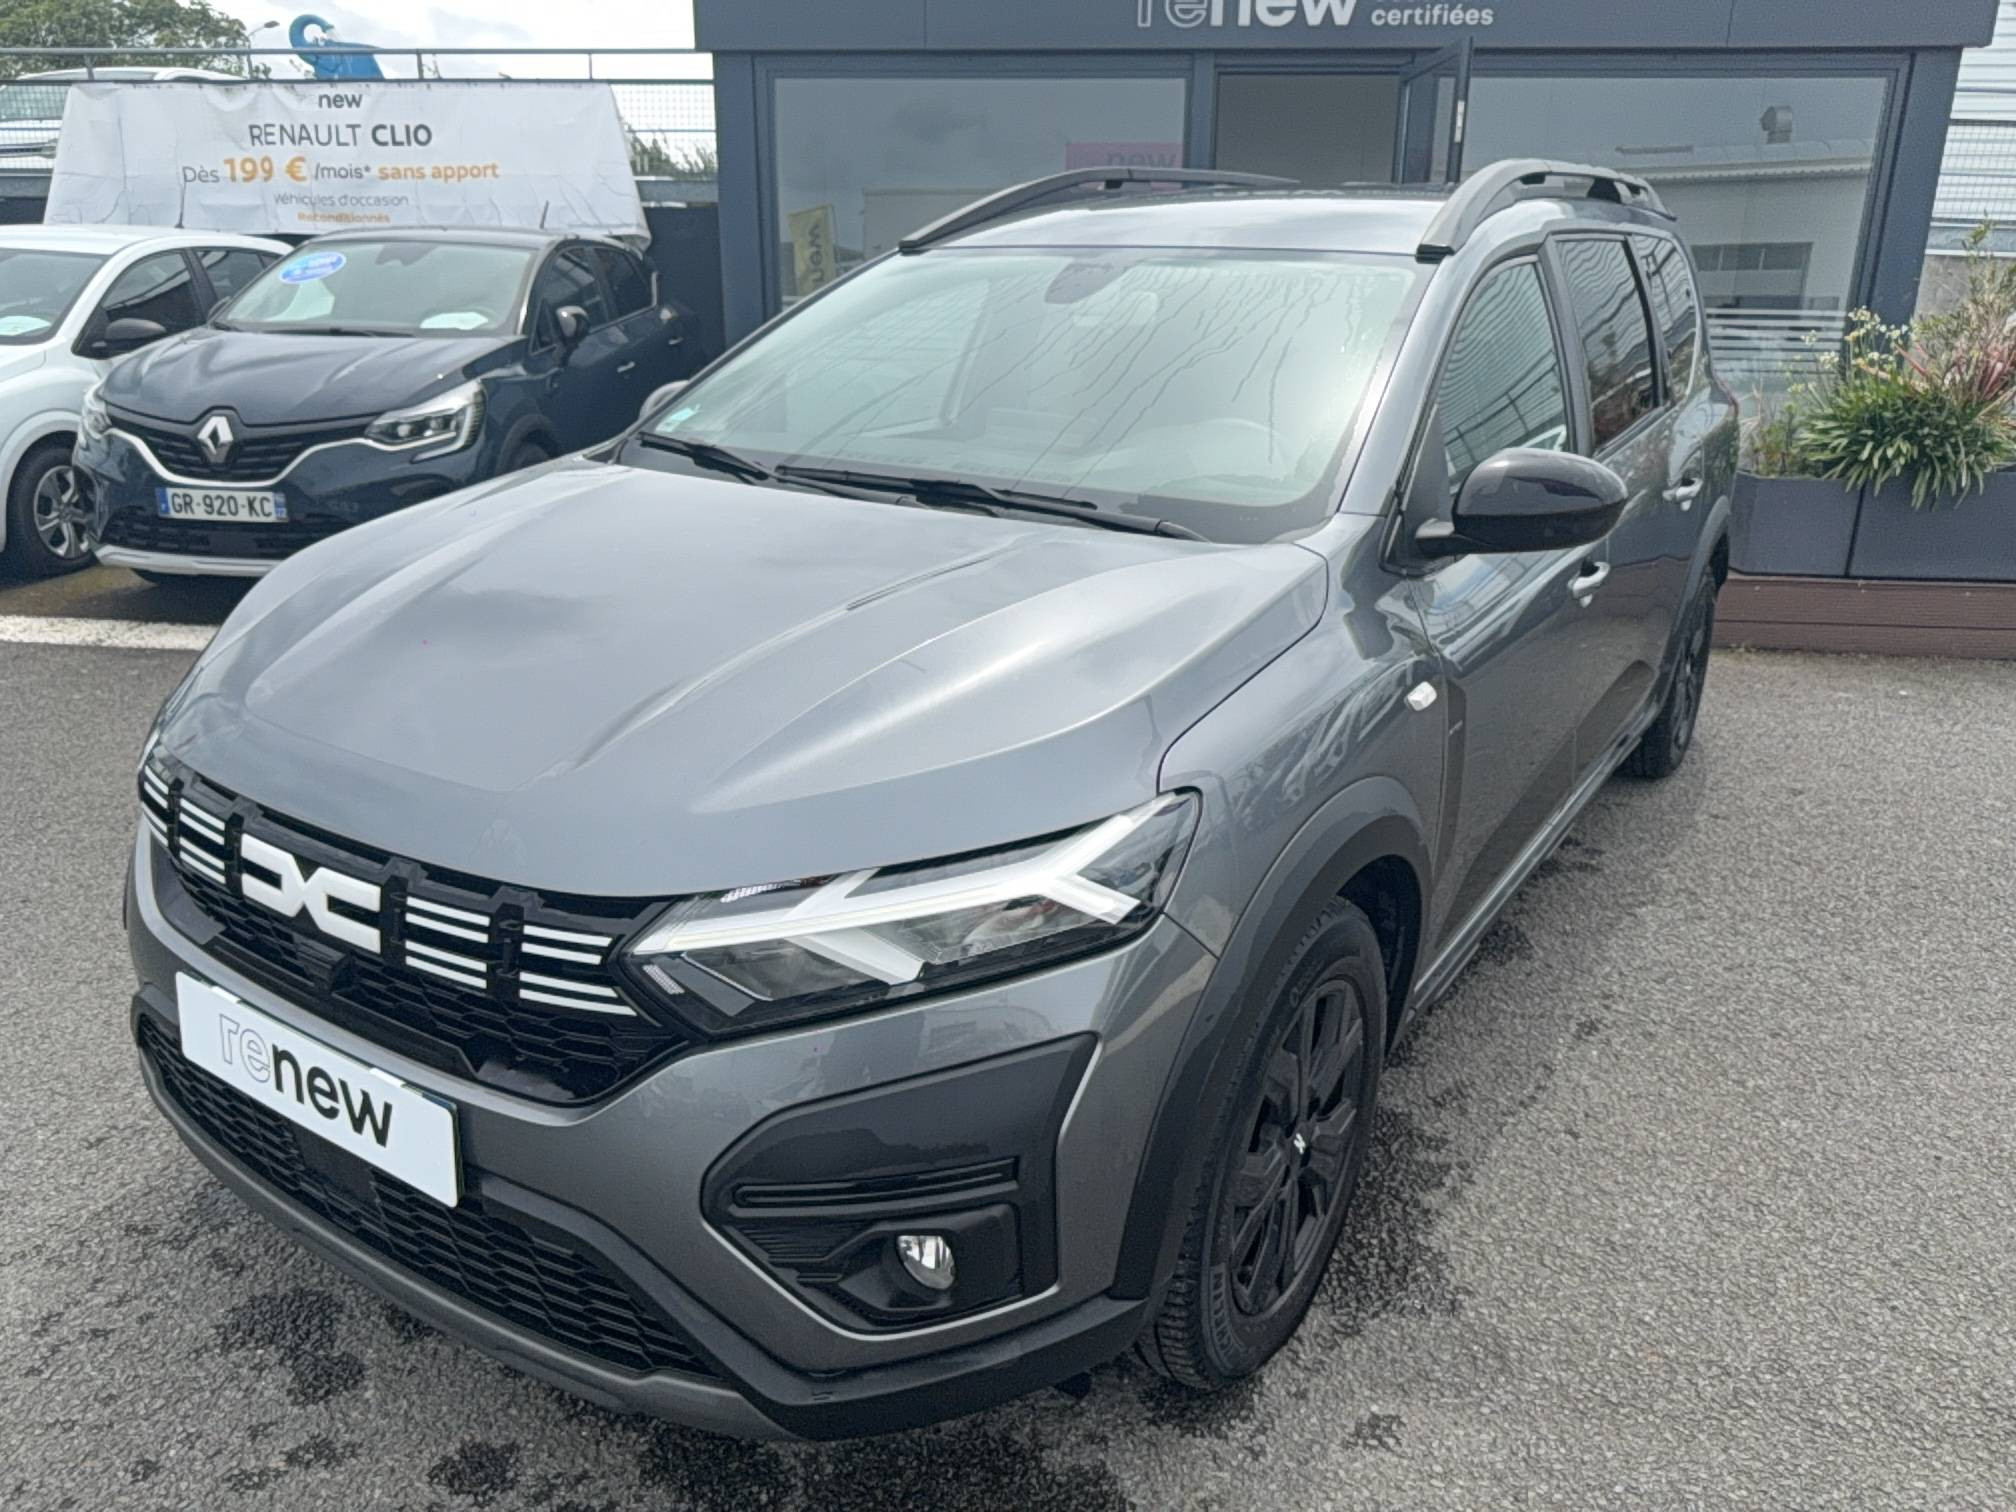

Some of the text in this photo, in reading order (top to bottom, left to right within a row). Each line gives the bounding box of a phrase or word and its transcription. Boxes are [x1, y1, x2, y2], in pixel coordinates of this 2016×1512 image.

[1371, 3, 1495, 26] certifiées
[248, 123, 433, 147] RENAULT CLIO
[182, 165, 220, 183] Dès
[223, 155, 273, 183] 199
[286, 156, 307, 182] €
[378, 164, 427, 180] sans
[431, 162, 499, 184] apport
[171, 492, 273, 517] GR-920-KC
[219, 1013, 393, 1149] renew
